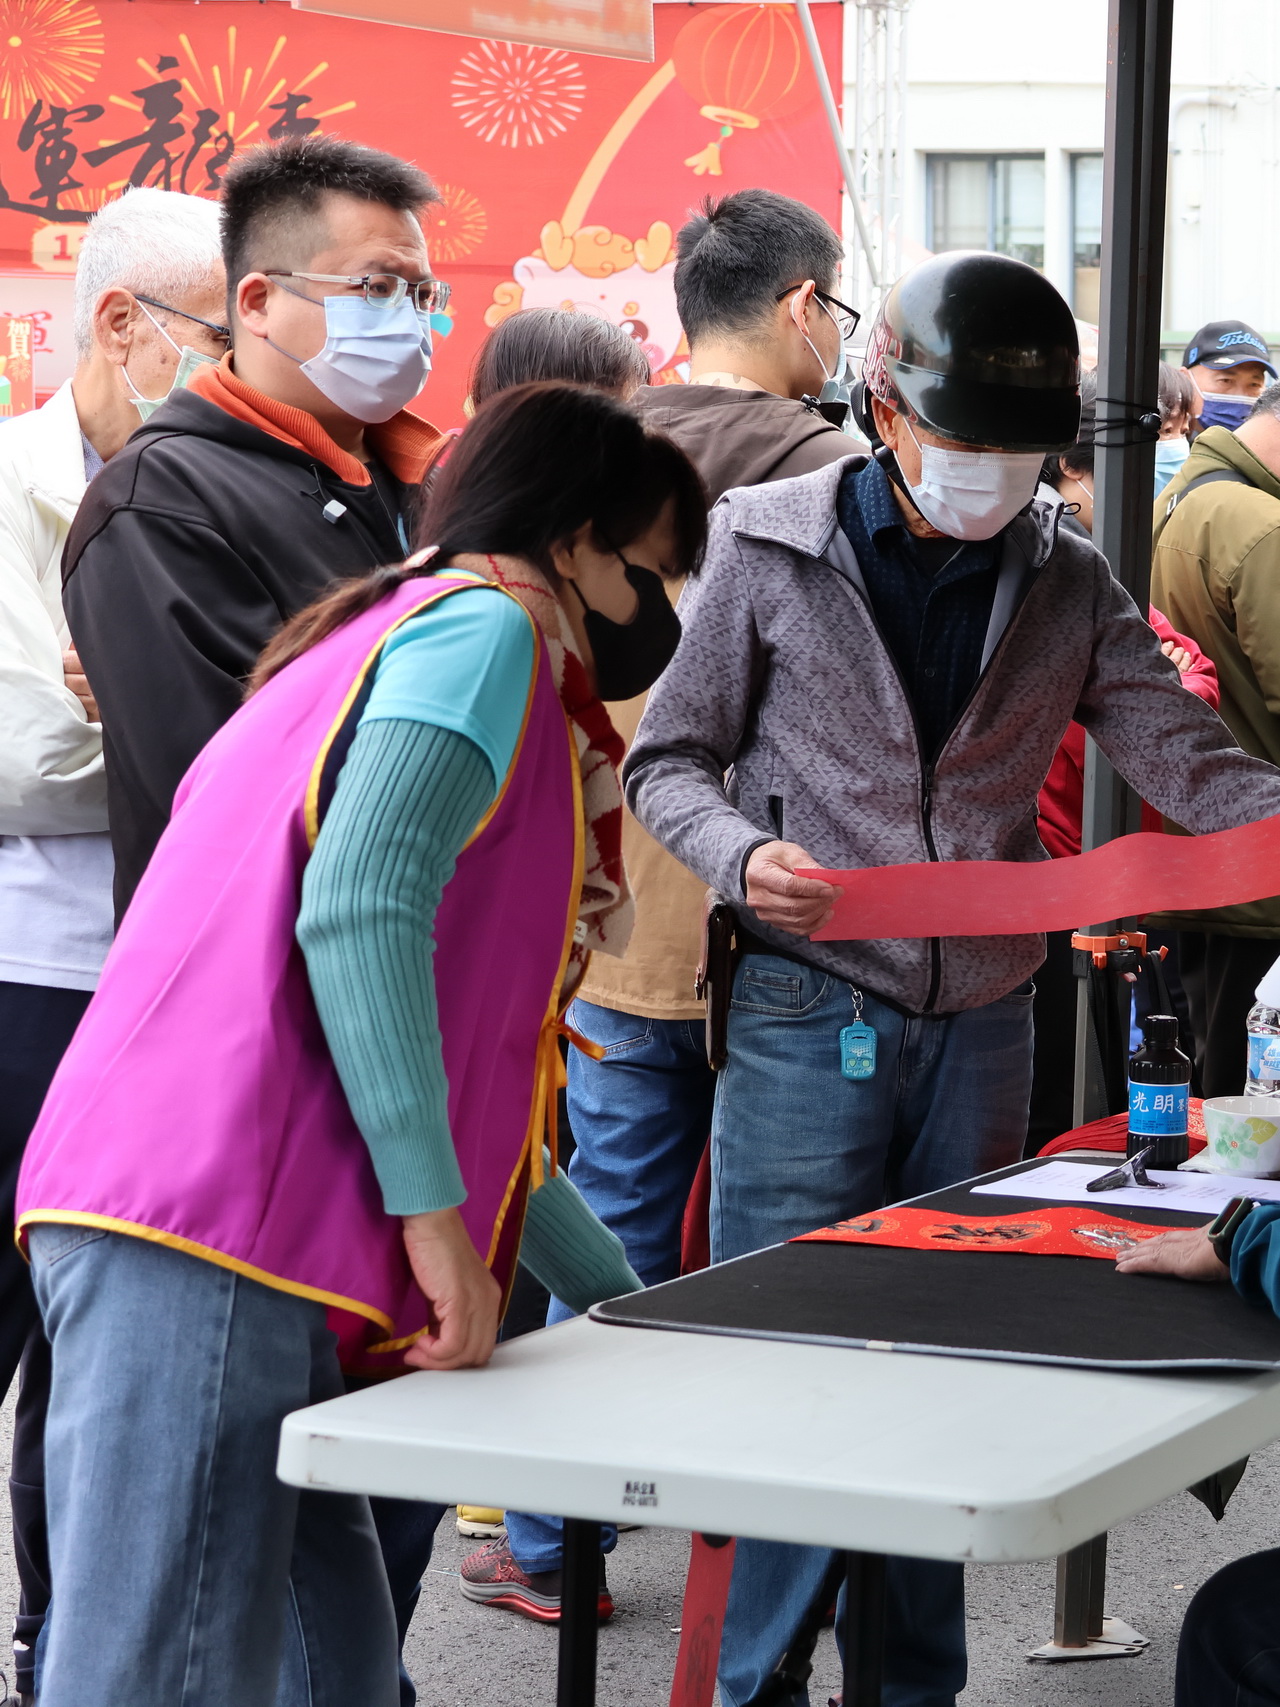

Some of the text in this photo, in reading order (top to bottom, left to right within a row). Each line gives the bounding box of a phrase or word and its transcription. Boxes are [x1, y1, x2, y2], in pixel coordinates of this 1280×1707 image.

[8, 319, 31, 360] 賀
[1129, 1090, 1189, 1114] 光明墨
